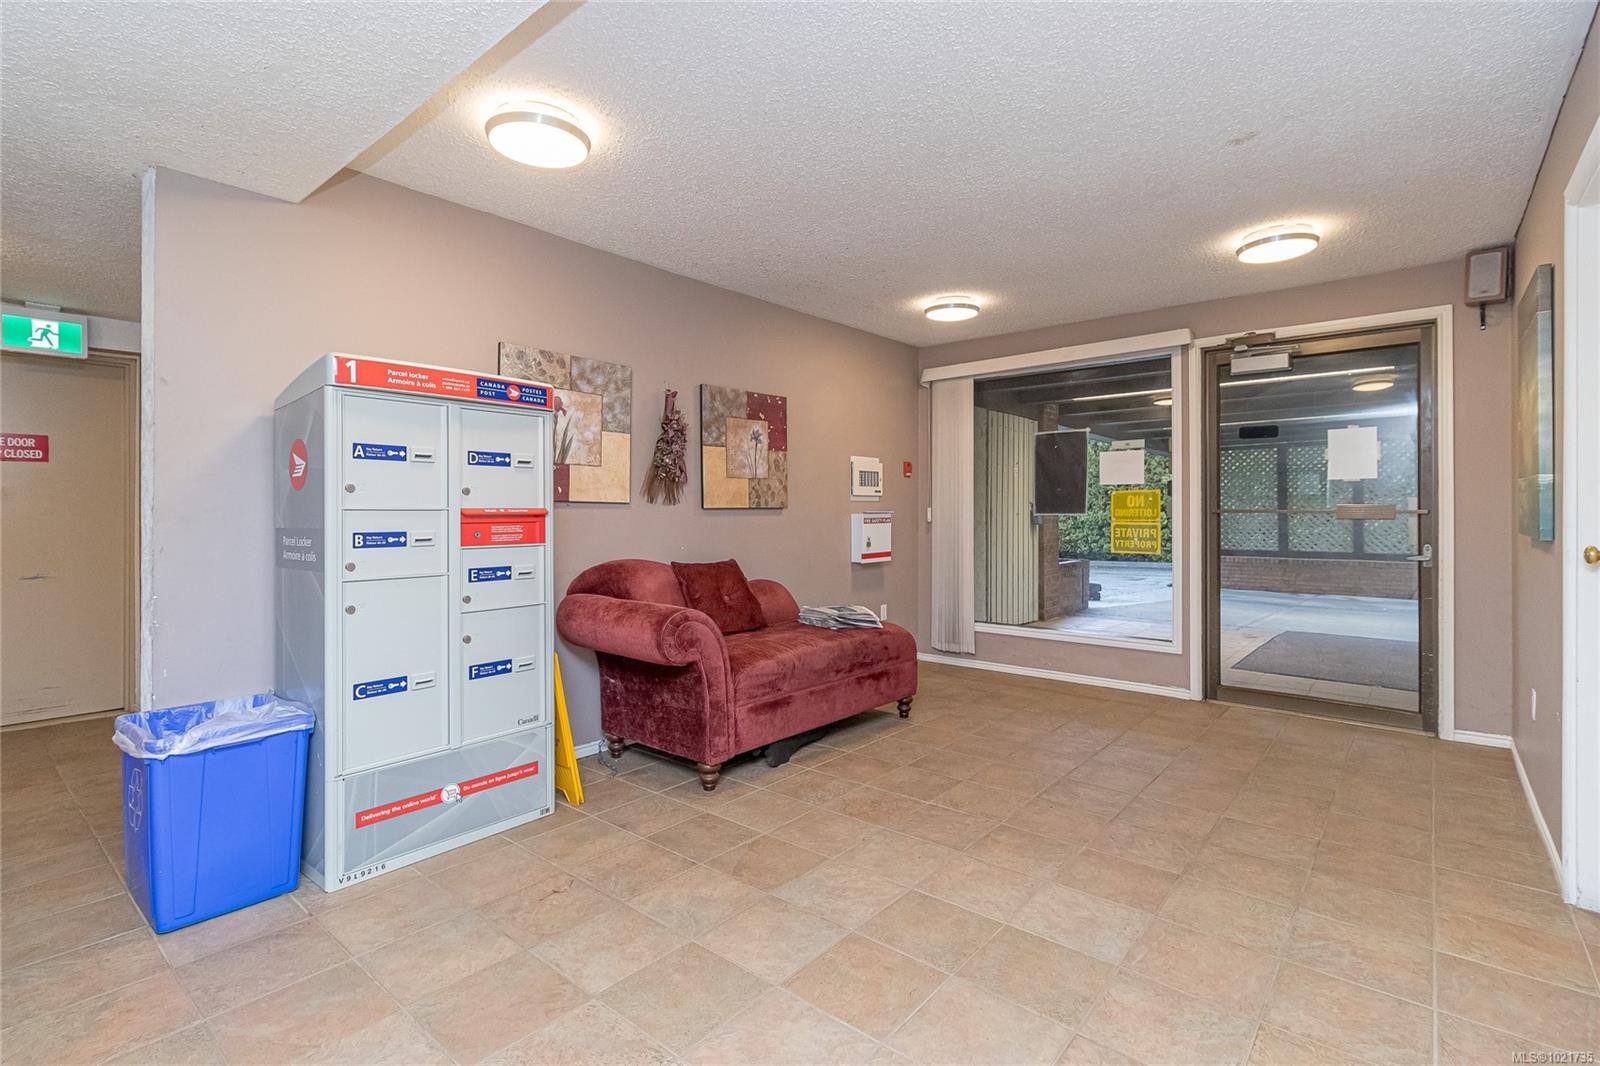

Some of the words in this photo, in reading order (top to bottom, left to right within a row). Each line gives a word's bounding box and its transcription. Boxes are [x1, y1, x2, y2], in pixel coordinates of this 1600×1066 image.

[345, 360, 357, 383] 1
[387, 369, 408, 378] Parcel
[409, 371, 429, 380] locker
[387, 377, 415, 386] Armoire
[422, 381, 437, 389] colis
[480, 381, 506, 390] CANADA
[522, 387, 542, 395] POSTES
[522, 396, 545, 404] CANADA
[7, 437, 36, 448] DOOR
[4, 448, 43, 459] CLOSED
[353, 445, 365, 458] A
[469, 452, 479, 464] D
[283, 536, 296, 546] Parcel
[297, 536, 312, 547] Locker
[354, 534, 364, 547] B
[283, 550, 301, 561] Armoire
[305, 551, 317, 562] colis
[471, 569, 478, 581] E
[472, 666, 479, 678] F
[355, 685, 367, 698] C
[517, 715, 539, 726] Canada
[471, 780, 488, 789] monde
[495, 774, 507, 783] ligne
[361, 808, 391, 822] Delivering
[402, 800, 420, 811] online
